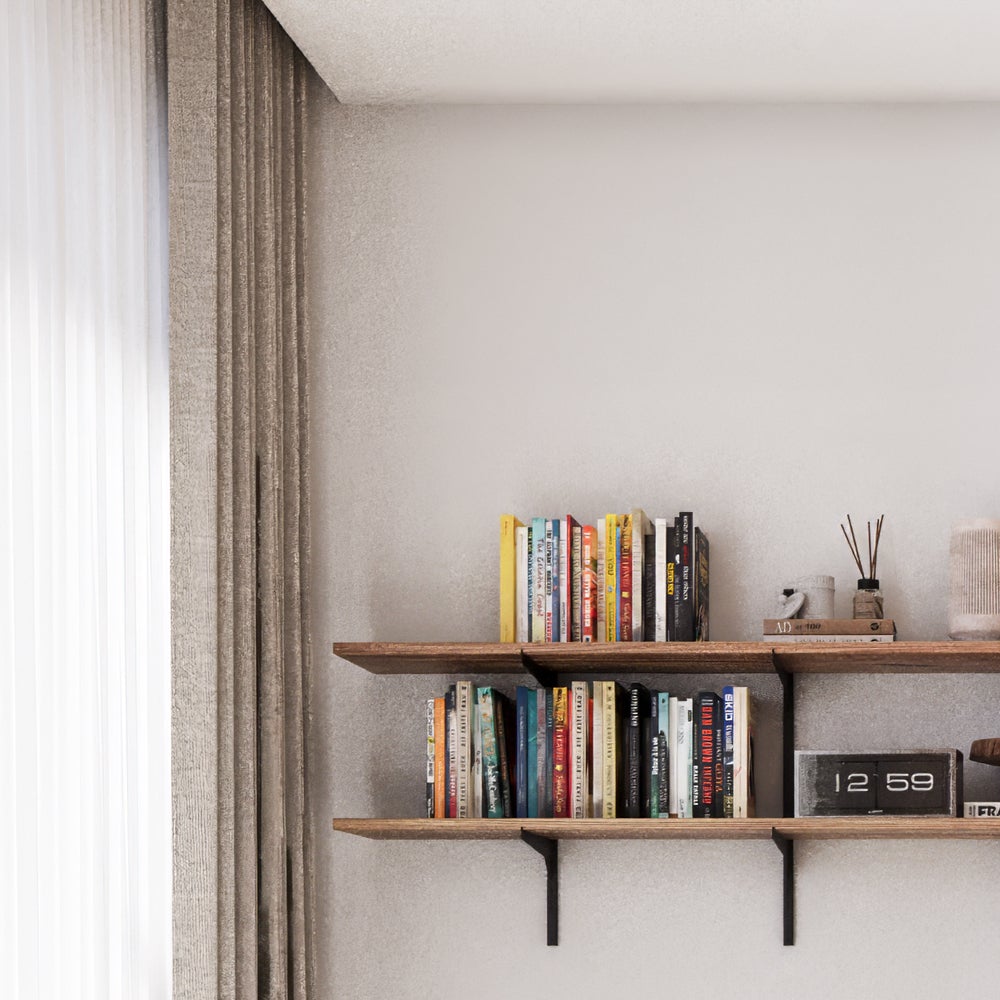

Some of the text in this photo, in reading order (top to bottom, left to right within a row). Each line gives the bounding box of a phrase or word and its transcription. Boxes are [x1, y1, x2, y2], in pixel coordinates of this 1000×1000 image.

[775, 621, 792, 633] AD
[702, 706, 713, 804] DAN BROWN INFERNO
[835, 773, 934, 792] 12 59
